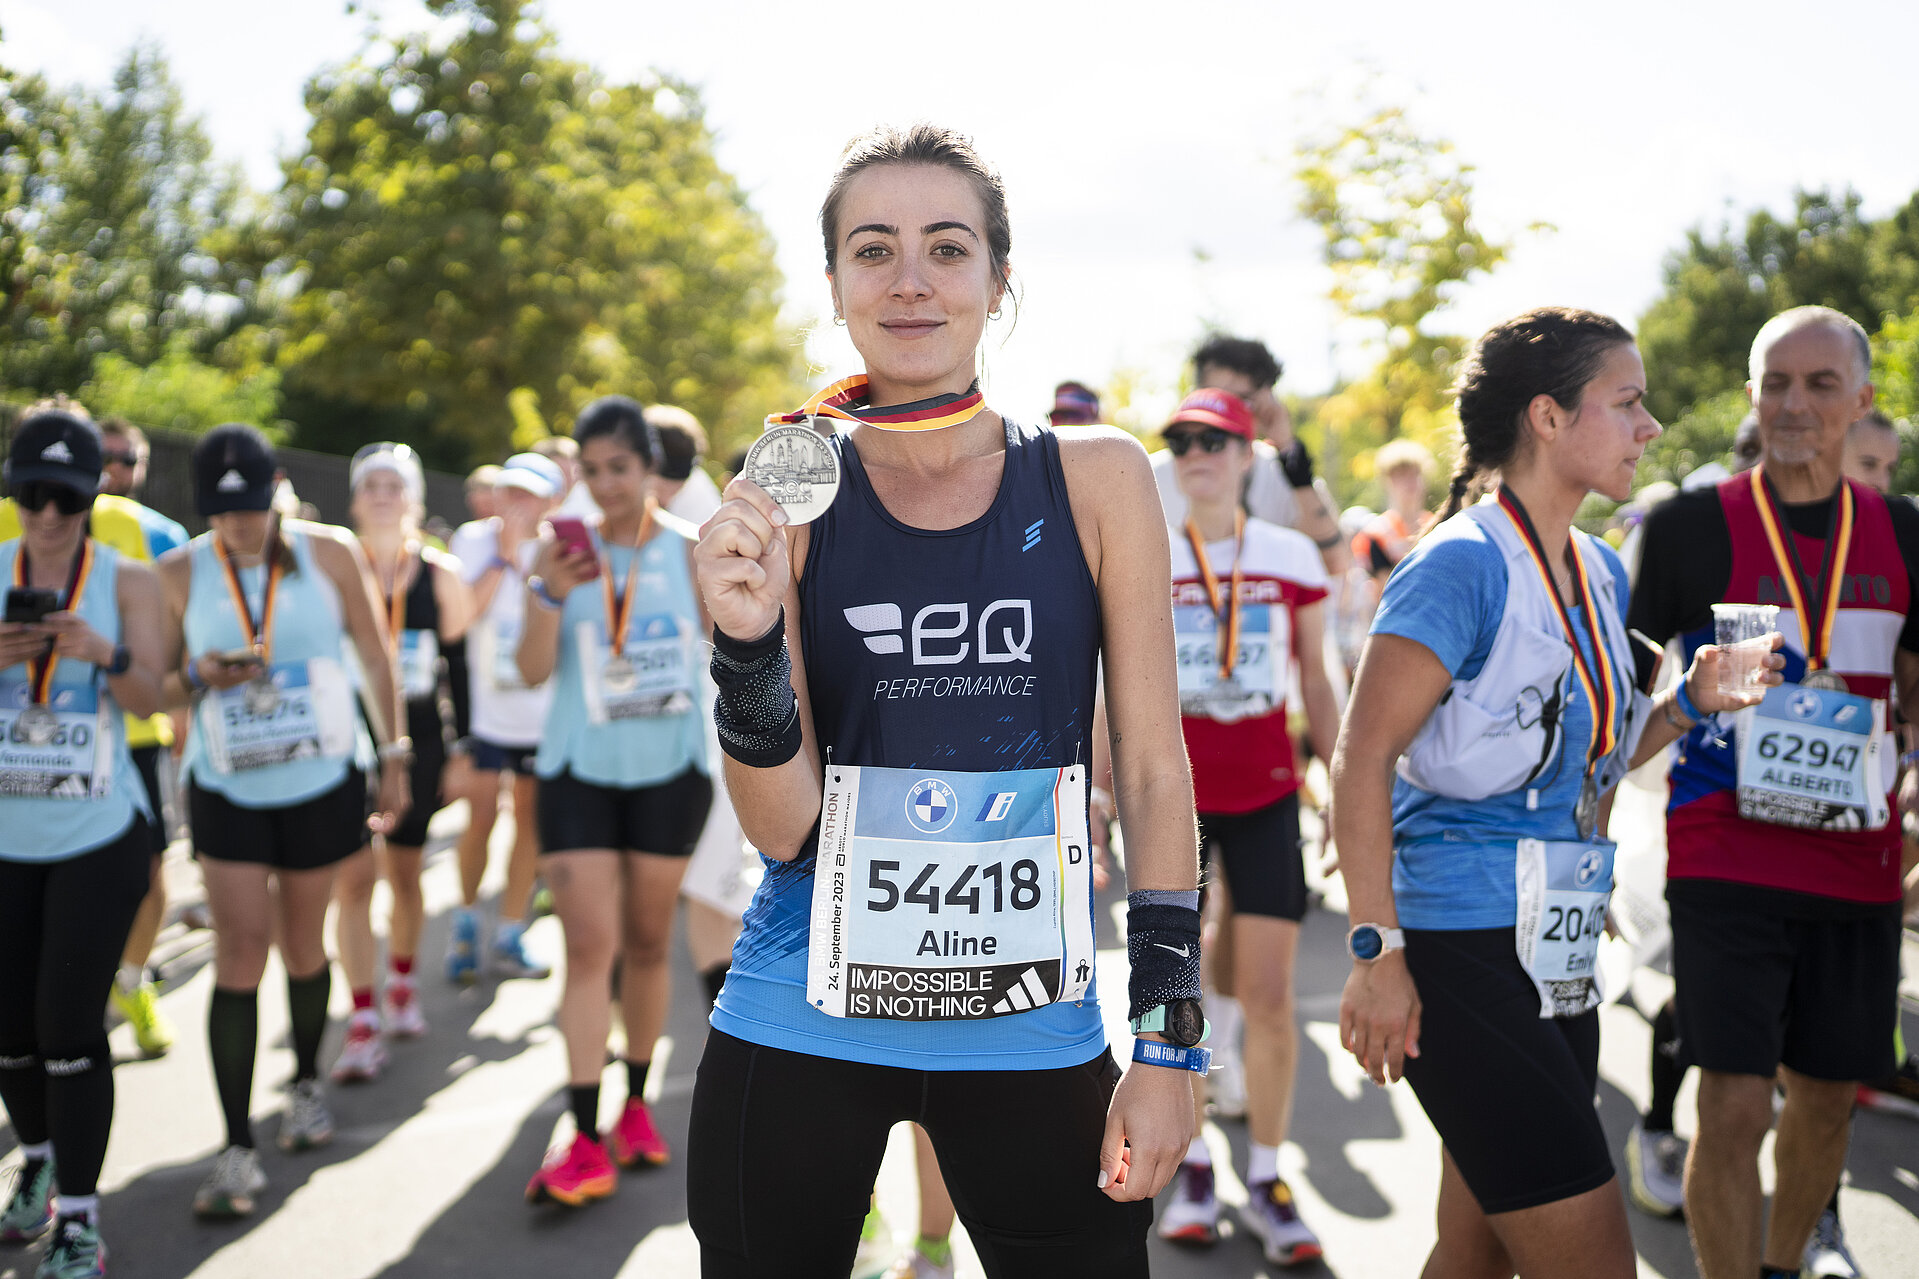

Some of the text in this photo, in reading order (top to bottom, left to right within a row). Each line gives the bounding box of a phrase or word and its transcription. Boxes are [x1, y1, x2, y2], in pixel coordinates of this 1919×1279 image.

[874, 675, 1037, 700] PERFORMANCE
[1758, 730, 1860, 772] 62947
[913, 781, 951, 798] BMW
[1760, 767, 1854, 797] ALBERTO
[1067, 845, 1082, 865] D
[867, 858, 1042, 915] 54418
[828, 872, 844, 990] 24. September 2023
[916, 930, 998, 957] Aline
[814, 931, 827, 966] BMW
[851, 968, 993, 993] IMPOSSIBLE
[850, 993, 987, 1017] IS NOTHING
[1143, 1044, 1187, 1063] RUN FOR JOY
